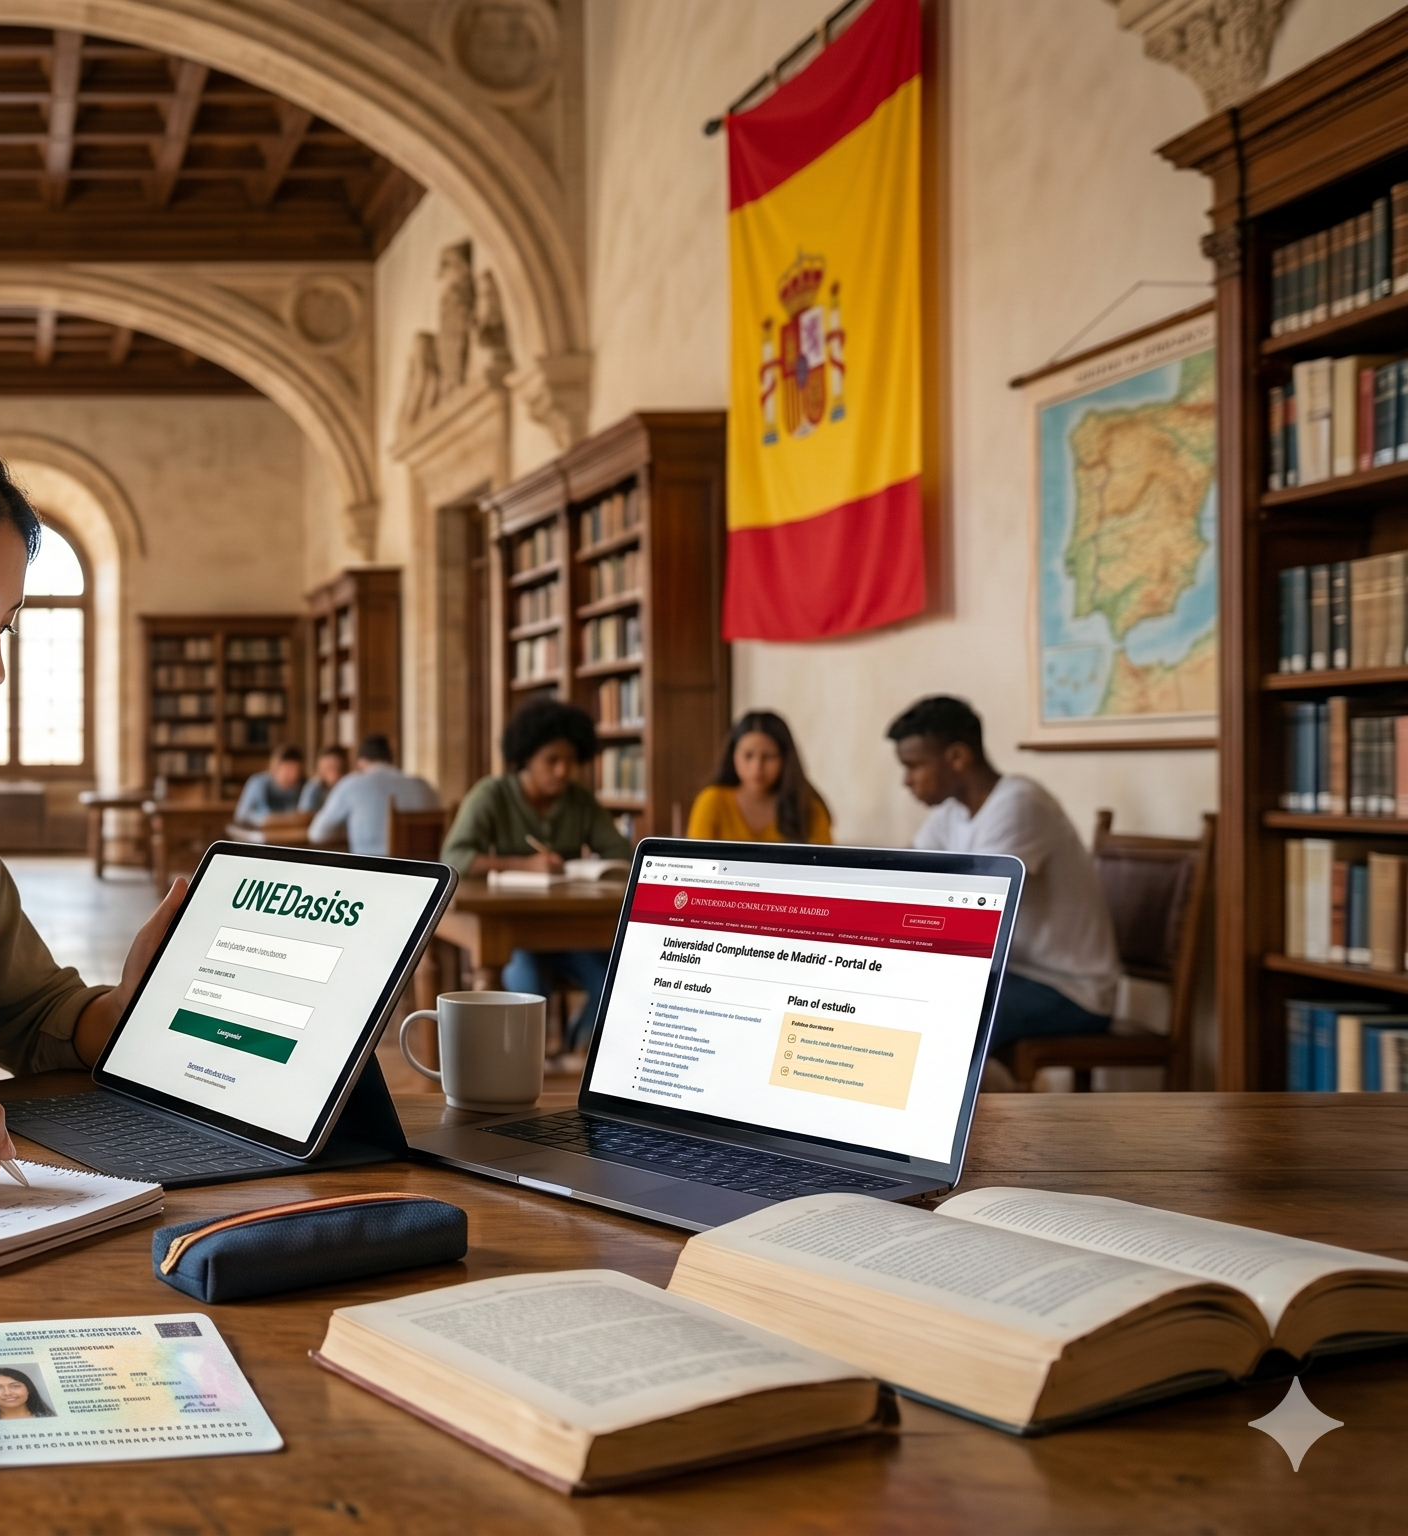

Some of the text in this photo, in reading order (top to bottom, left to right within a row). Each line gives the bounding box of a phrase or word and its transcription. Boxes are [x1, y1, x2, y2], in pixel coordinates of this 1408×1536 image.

[231, 878, 364, 927] UNEDasiss
[663, 937, 714, 953] Universidad
[715, 942, 775, 960] Complutense
[776, 949, 790, 961] de
[834, 956, 867, 971] Portal
[868, 959, 883, 972] de
[653, 977, 672, 989] Plan
[684, 983, 712, 994] estudo
[787, 995, 809, 1007] Plan
[821, 1002, 856, 1014] estudio
